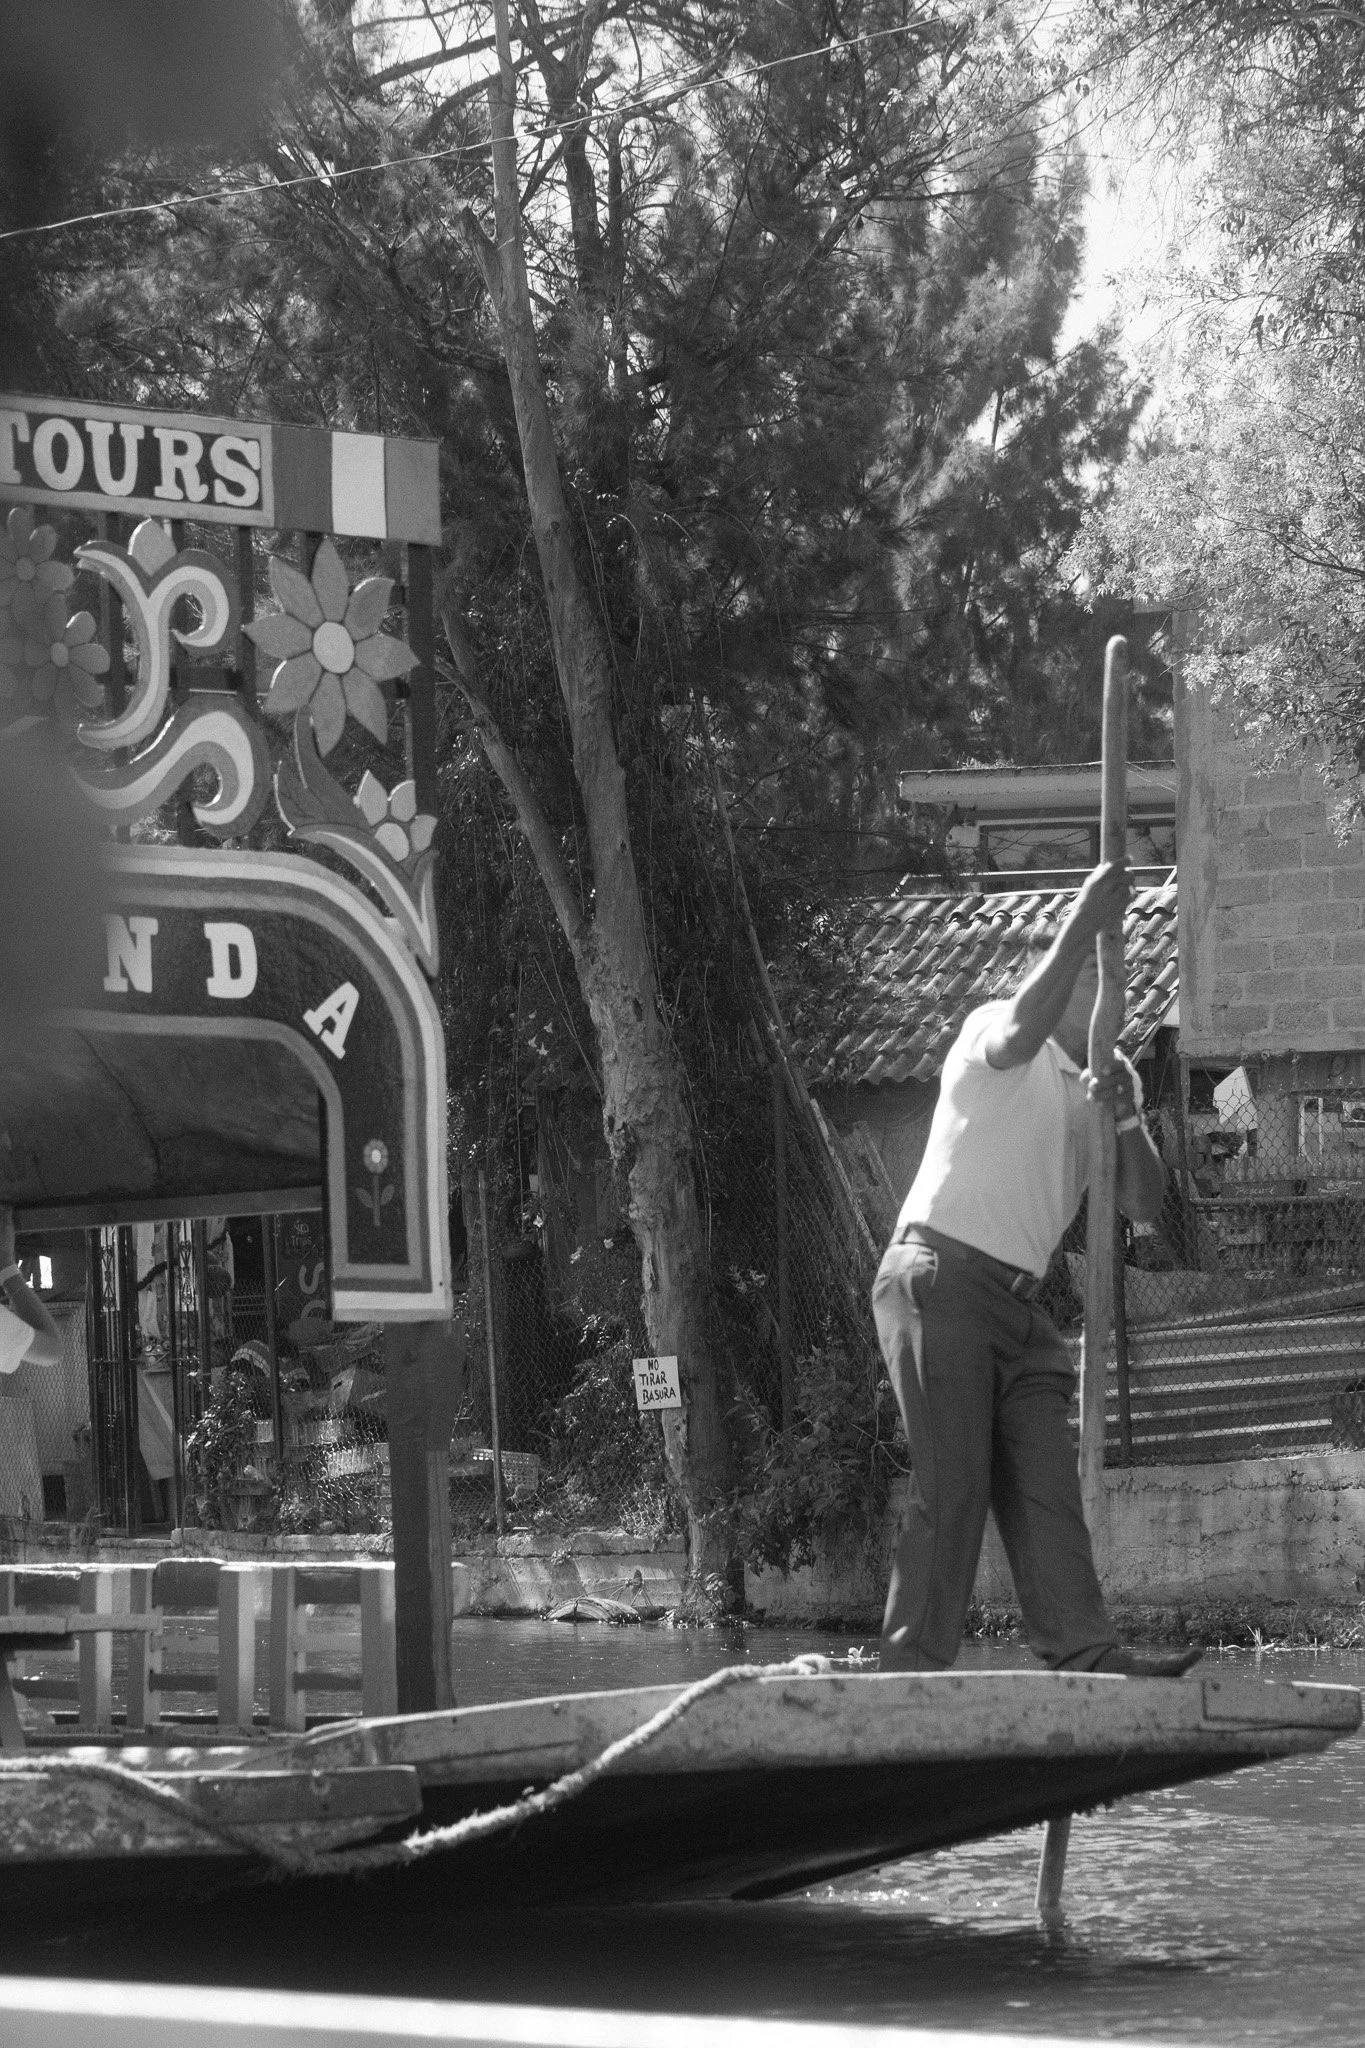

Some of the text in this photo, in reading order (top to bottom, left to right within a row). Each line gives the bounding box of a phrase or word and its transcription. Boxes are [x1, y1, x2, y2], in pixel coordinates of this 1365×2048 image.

[0, 409, 261, 508] TOURS
[647, 1358, 660, 1372] NO
[638, 1370, 668, 1387] TIRAR
[642, 1386, 677, 1405] BASURA
